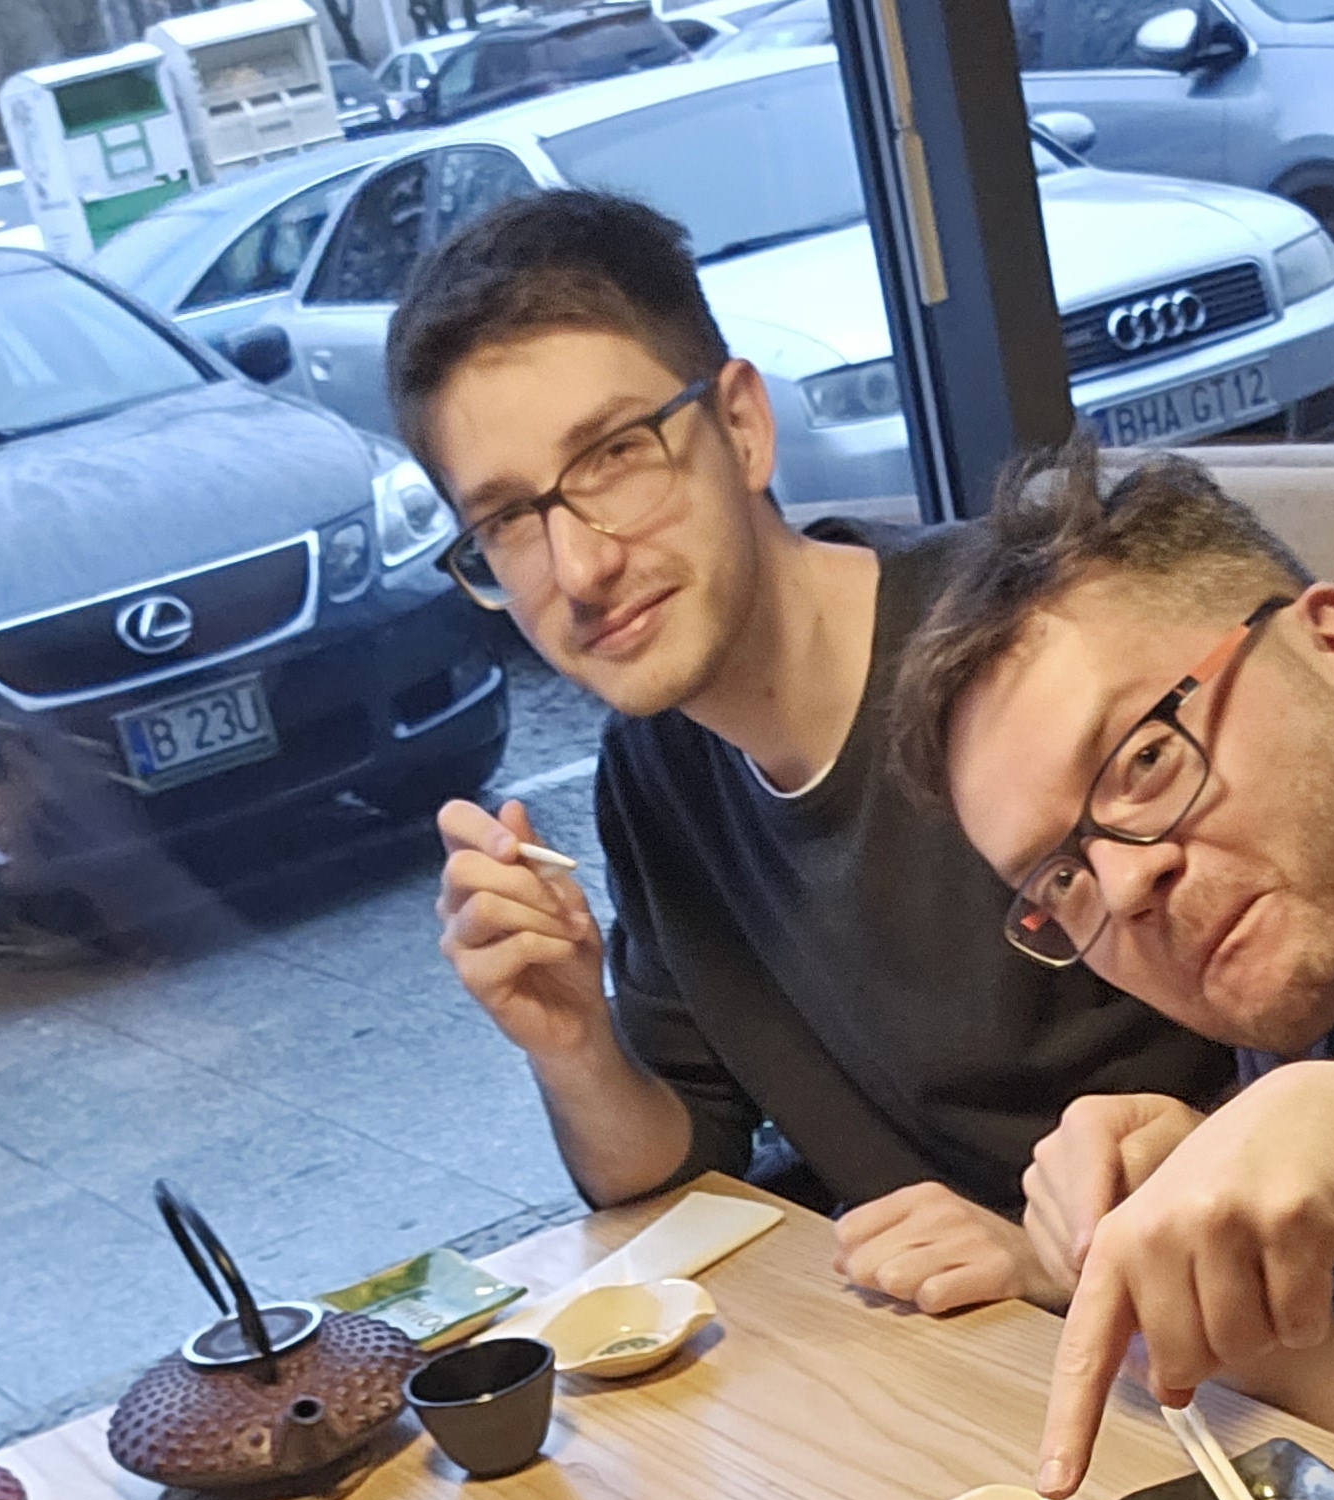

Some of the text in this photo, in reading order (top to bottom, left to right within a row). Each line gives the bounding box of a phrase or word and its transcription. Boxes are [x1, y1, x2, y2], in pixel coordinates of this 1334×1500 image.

[1117, 367, 1267, 447] BHA GT12
[150, 690, 260, 762] B 23U
